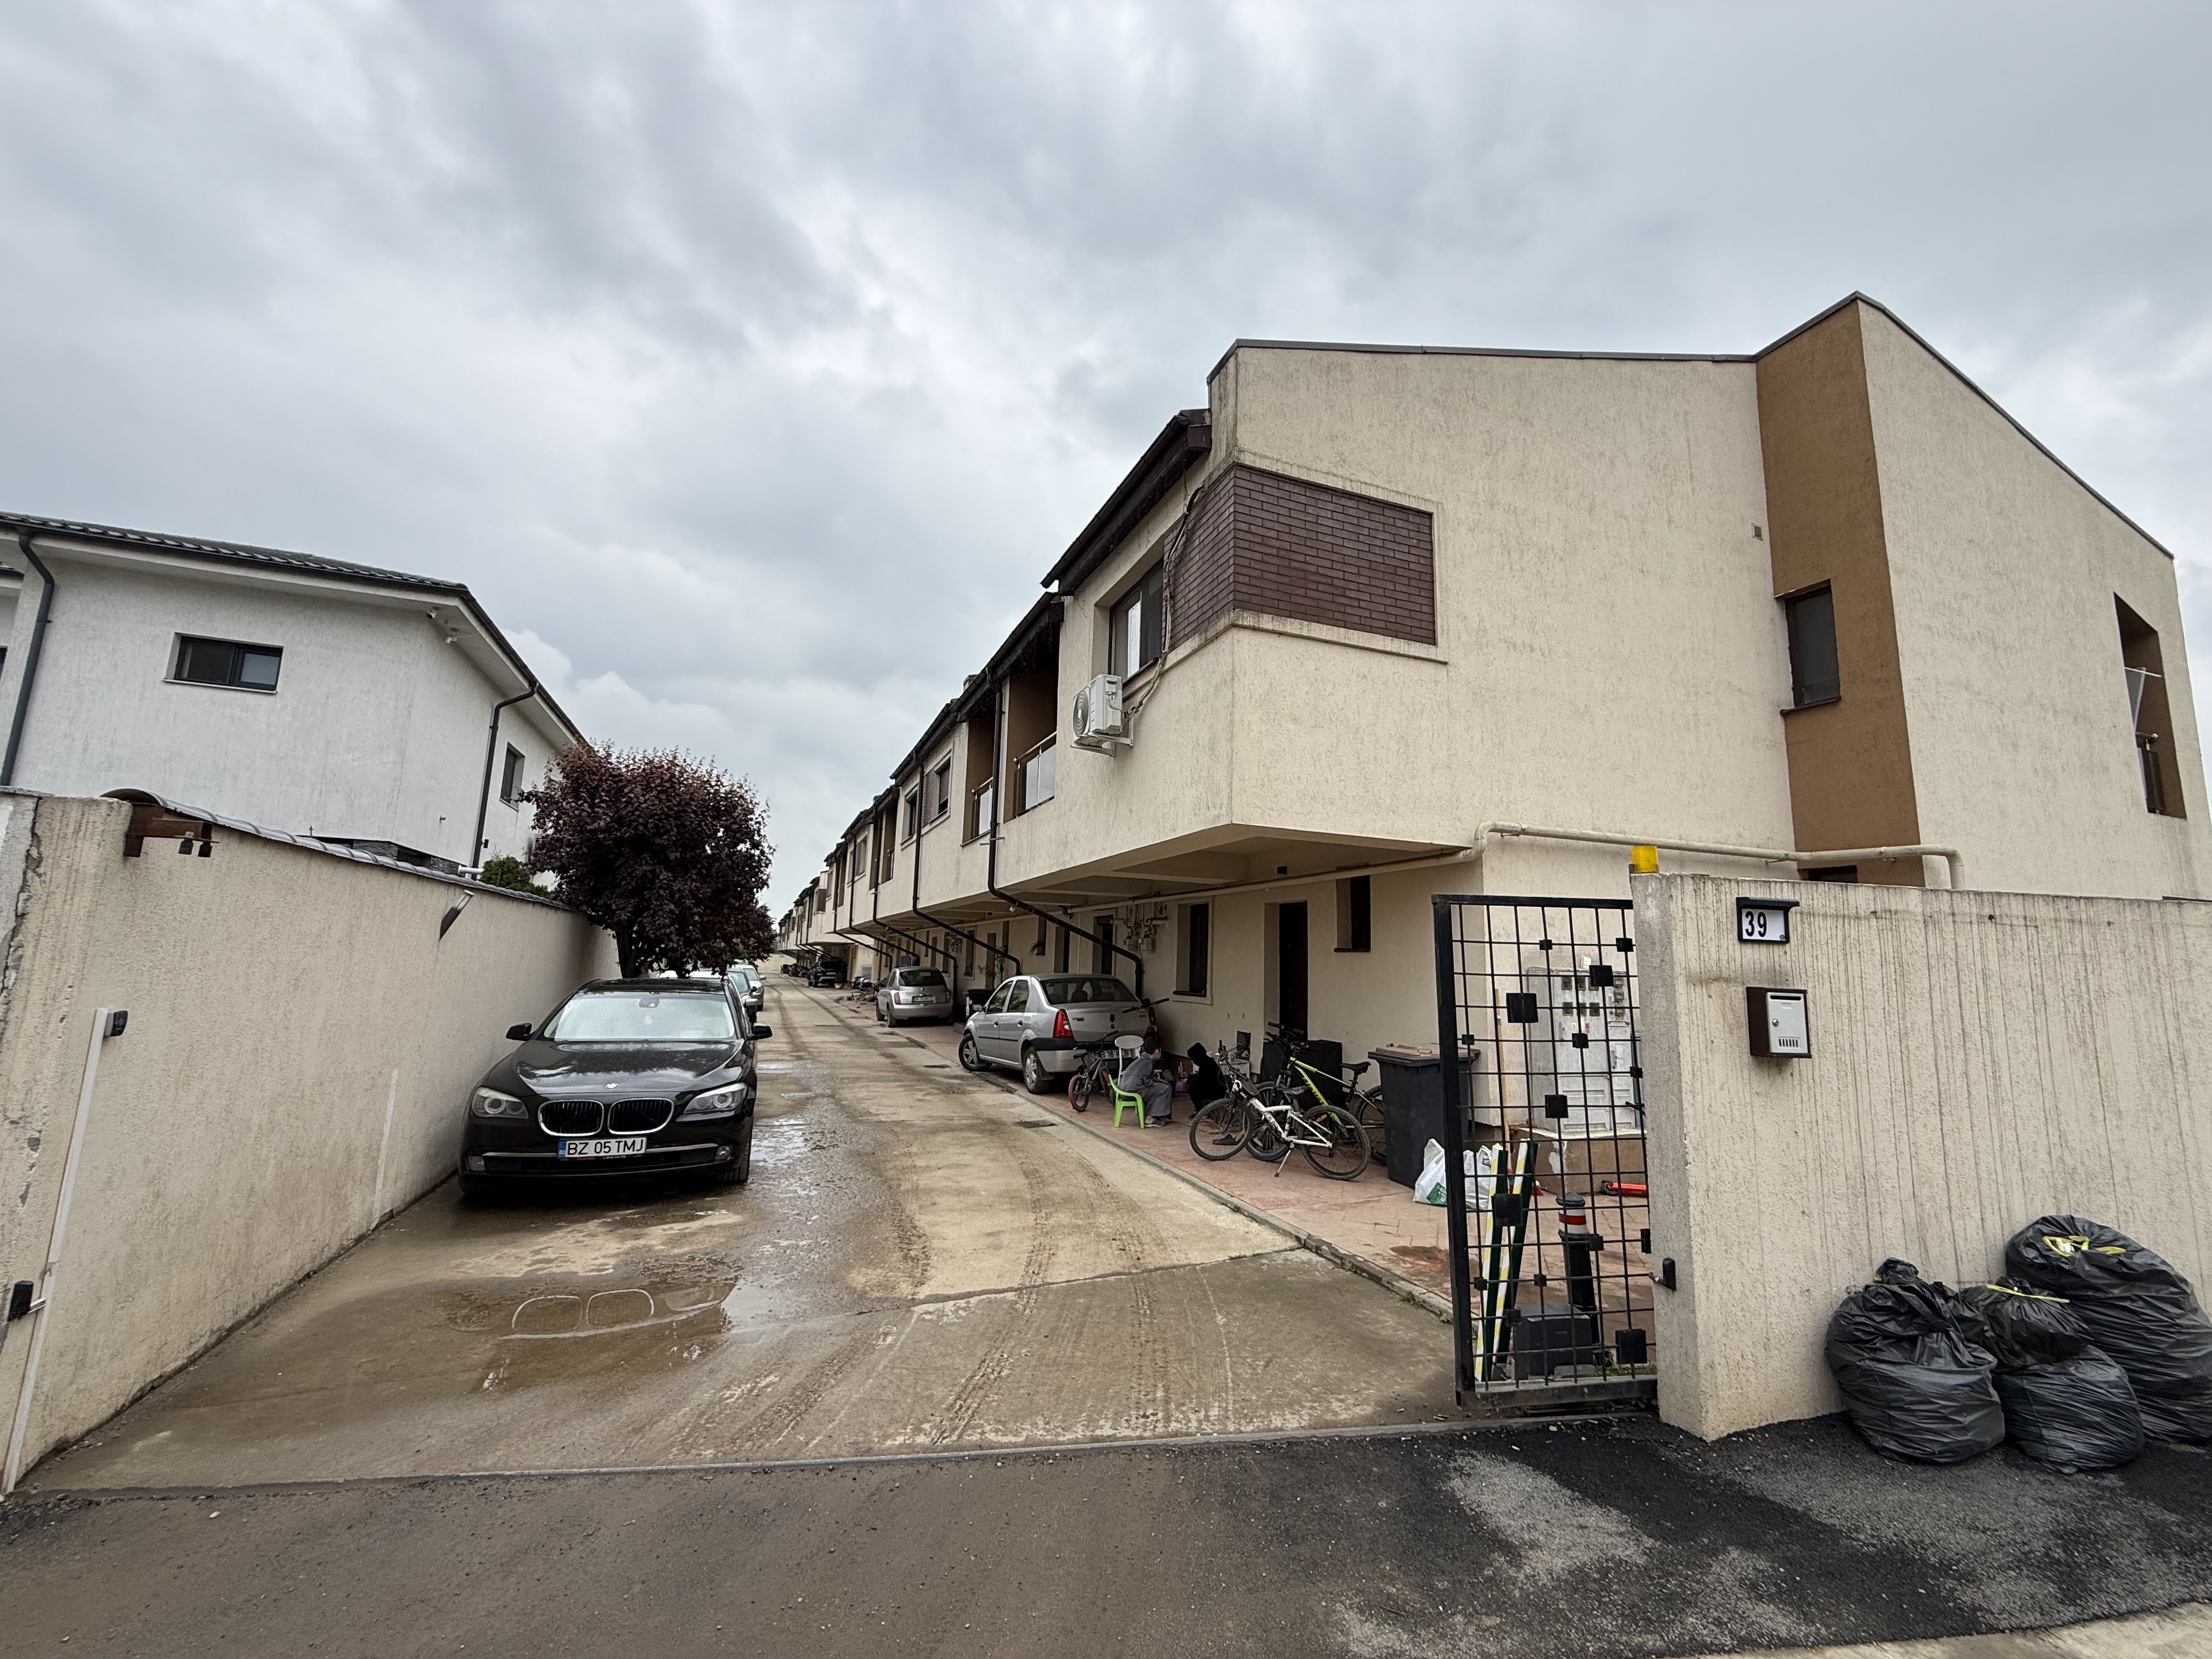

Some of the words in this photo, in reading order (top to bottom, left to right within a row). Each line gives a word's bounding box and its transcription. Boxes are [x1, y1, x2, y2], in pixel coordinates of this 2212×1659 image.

[1745, 911, 1767, 938] 39
[567, 1142, 589, 1155] BZ
[594, 1141, 611, 1154] 05
[615, 1139, 644, 1153] TMJ
